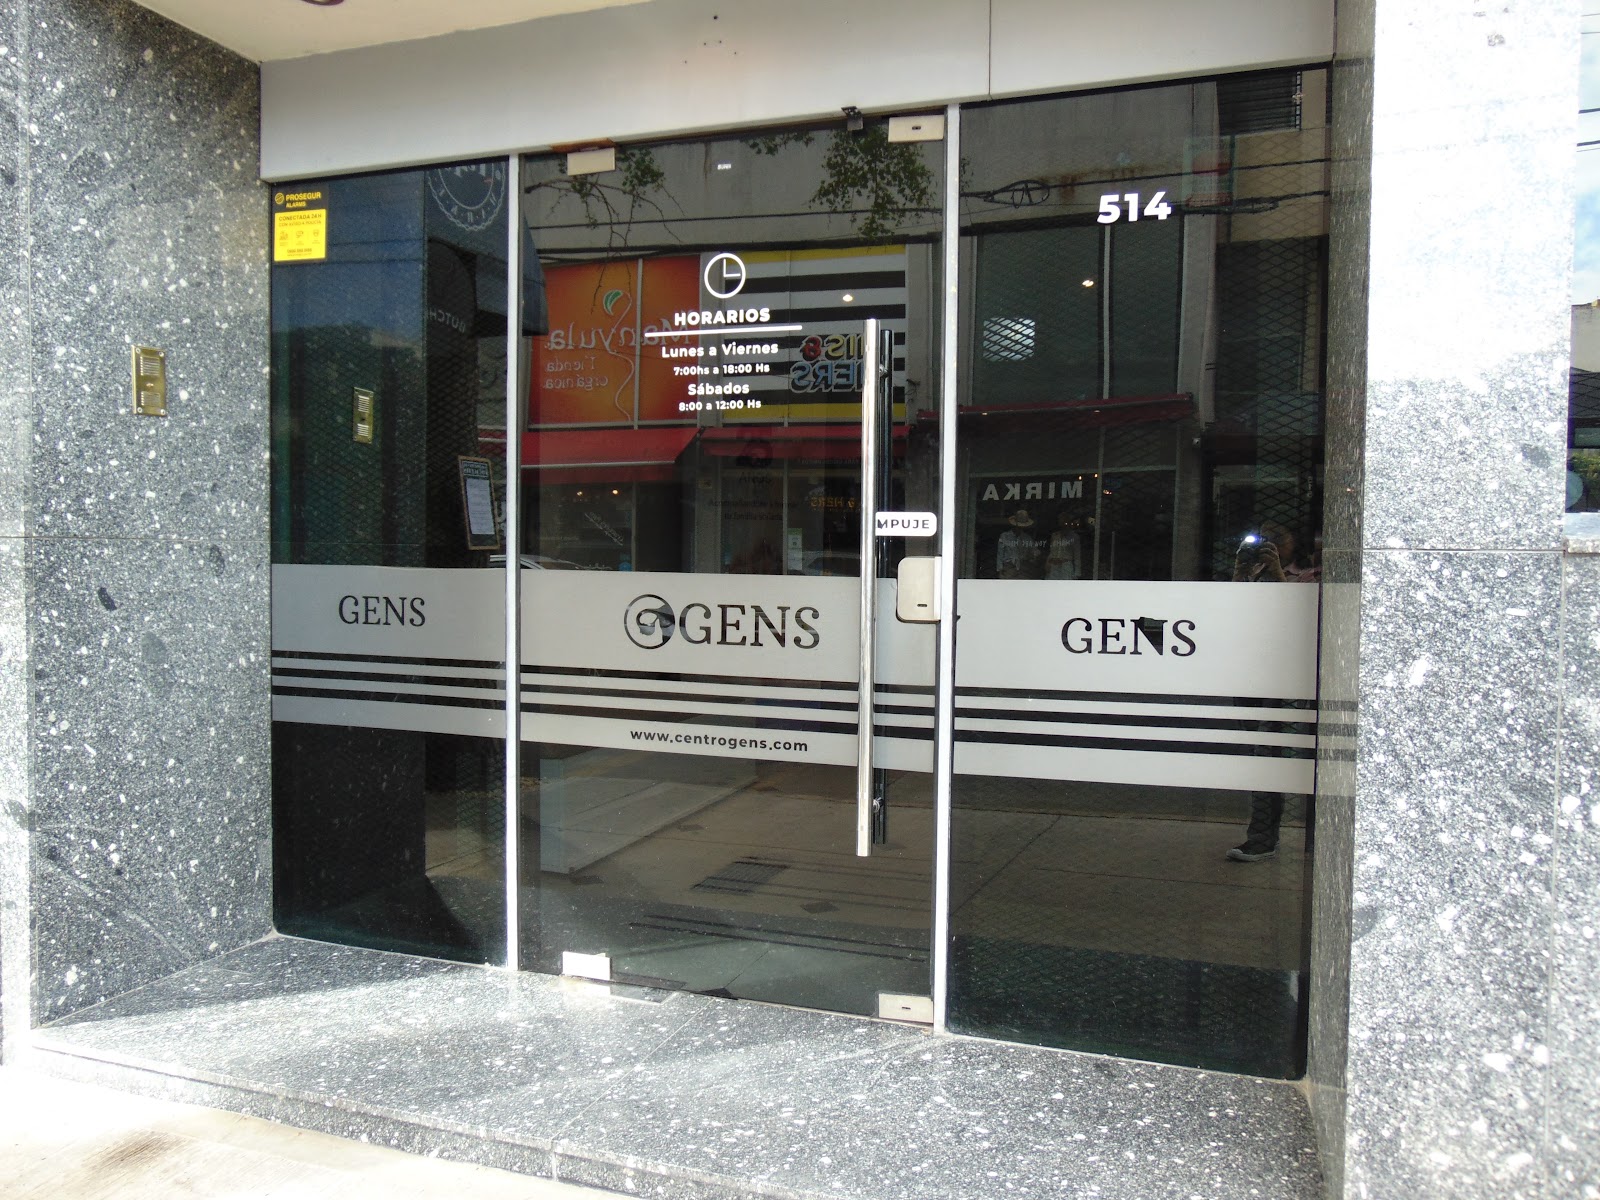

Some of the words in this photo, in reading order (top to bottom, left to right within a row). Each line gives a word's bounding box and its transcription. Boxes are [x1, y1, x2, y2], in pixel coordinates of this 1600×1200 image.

[286, 192, 321, 201] PROSEGUR
[1097, 191, 1172, 224] 514
[673, 307, 771, 327] HORARIOS
[661, 344, 705, 359] Lunes
[708, 347, 718, 357] a
[721, 341, 780, 356] Viernes
[673, 363, 710, 377] 7:00hs
[712, 367, 720, 375] a
[722, 363, 753, 375] 18:00
[755, 362, 771, 374] Hs
[687, 381, 751, 396] Sábados
[678, 400, 704, 413] 8:00
[706, 403, 713, 411] a
[715, 399, 745, 411] 12:00
[747, 398, 762, 410] Hs
[877, 518, 930, 530] MPUJE
[338, 595, 426, 628] GENS
[680, 602, 821, 650] GENS
[1061, 616, 1197, 657] GENS
[629, 729, 809, 753] www.centrogens.com
